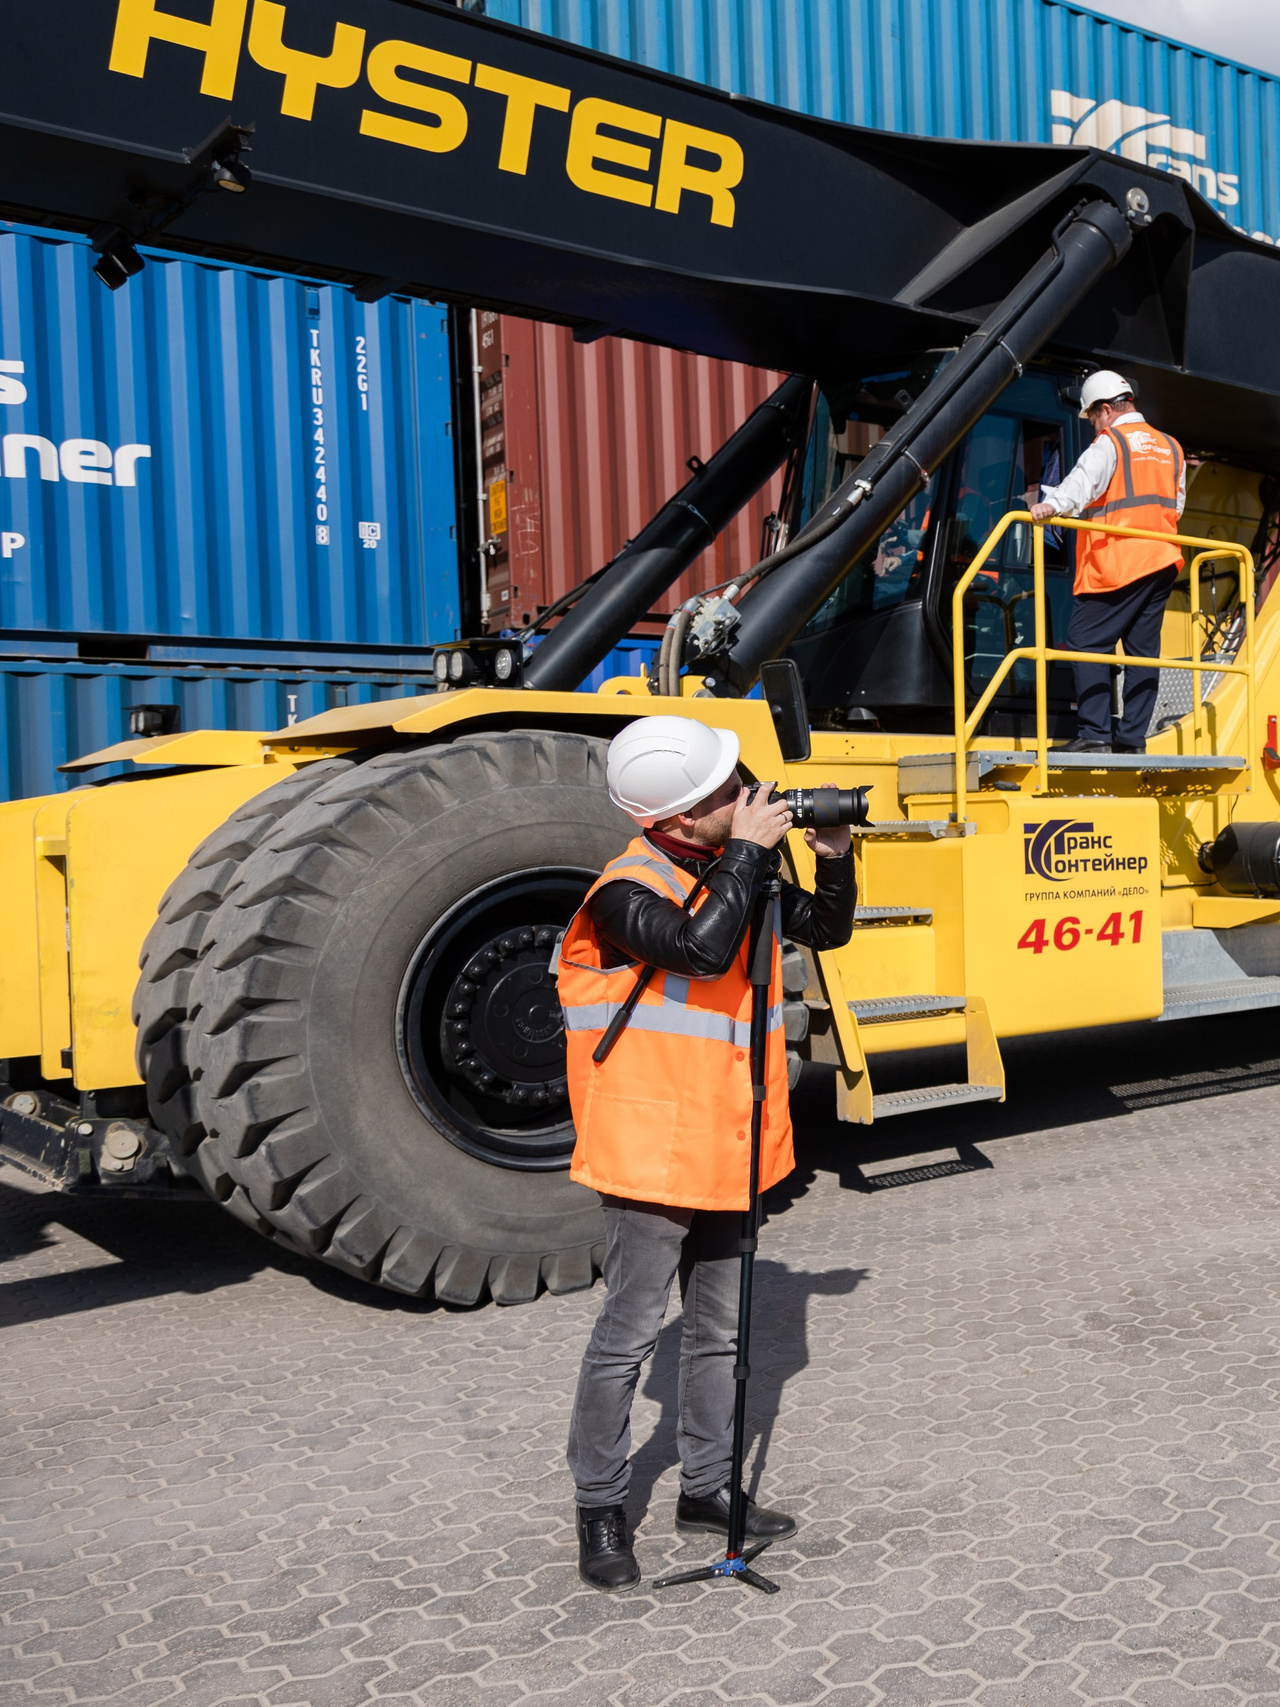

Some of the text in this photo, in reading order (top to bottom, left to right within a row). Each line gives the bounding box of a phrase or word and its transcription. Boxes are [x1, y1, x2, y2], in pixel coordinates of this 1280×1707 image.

[109, 0, 744, 228] HYSTER
[355, 336, 368, 411] 22G1
[0, 433, 152, 487] ner
[362, 539, 377, 549] 20
[1025, 886, 1149, 902] ГРУППА КОМПАНИЙ «ДЕЛО»
[1017, 910, 1143, 955] 46-41
